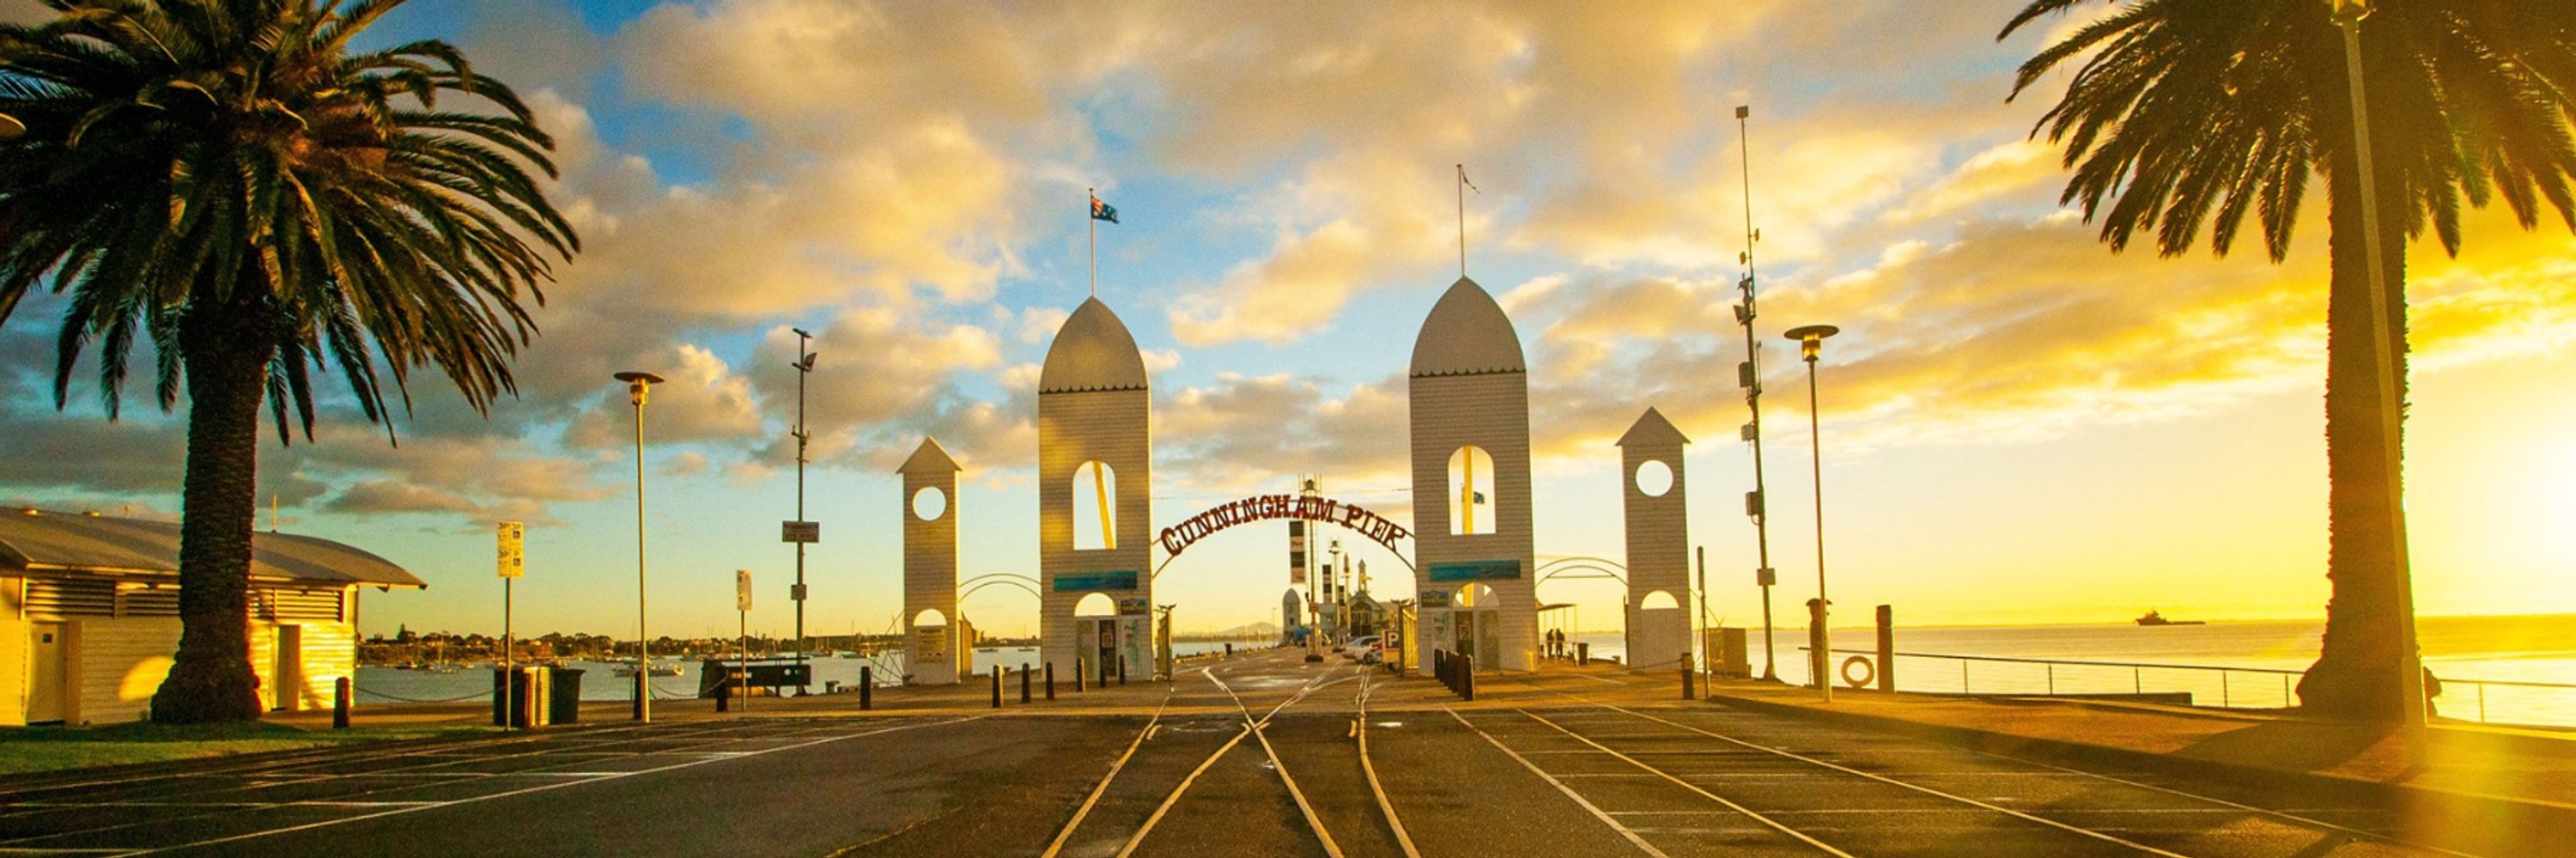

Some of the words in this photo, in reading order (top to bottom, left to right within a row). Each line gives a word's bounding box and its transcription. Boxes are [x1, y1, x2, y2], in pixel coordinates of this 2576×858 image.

[1161, 495, 1338, 557] CUNNINGHAM
[1340, 504, 1406, 552] PIER
[1388, 632, 1399, 647] P
